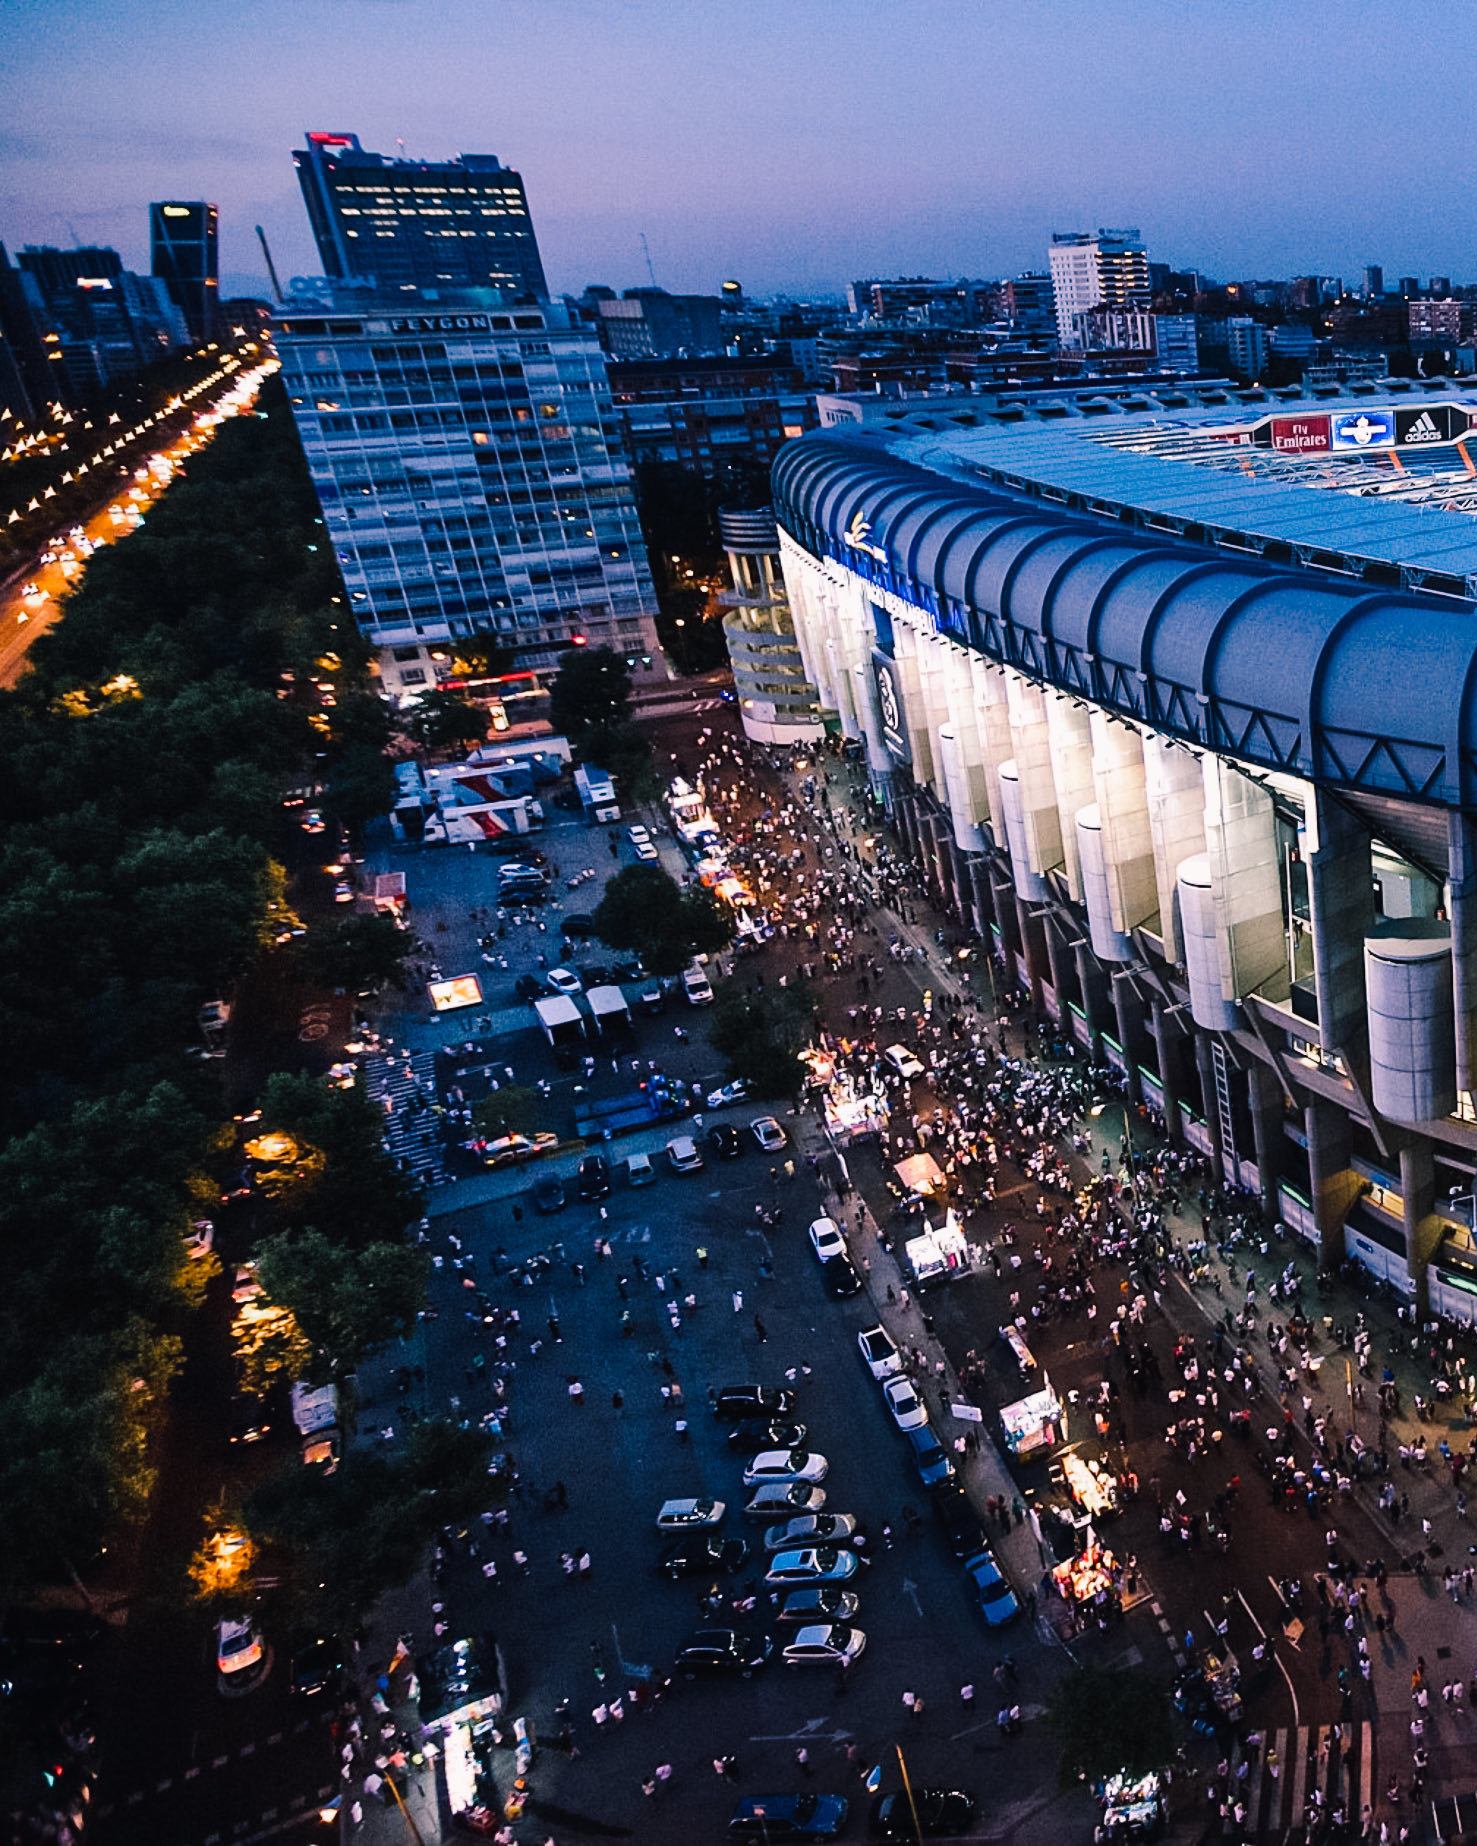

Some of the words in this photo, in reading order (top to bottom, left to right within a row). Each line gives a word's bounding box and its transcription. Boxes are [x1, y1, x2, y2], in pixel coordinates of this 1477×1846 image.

[391, 317, 487, 330] FEYGON
[1293, 425, 1309, 435] Fly
[1404, 430, 1442, 442] adidas
[1276, 434, 1327, 448] Emirates
